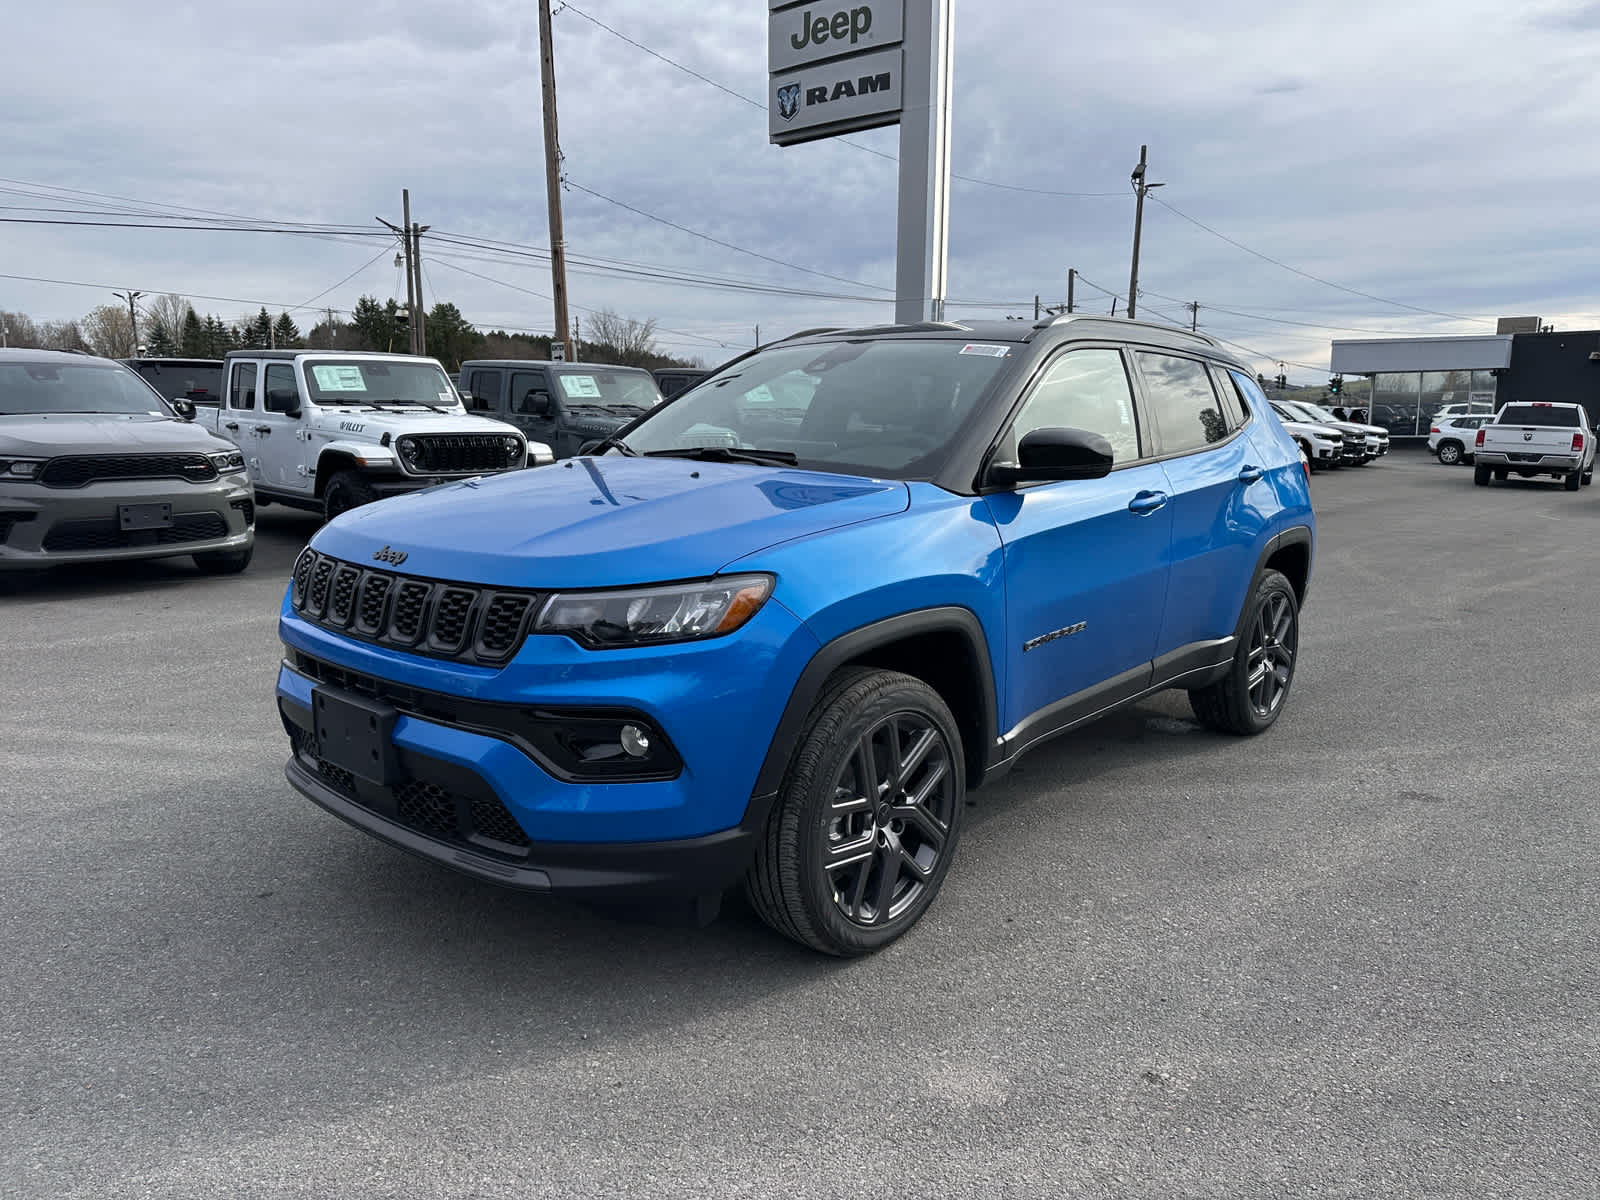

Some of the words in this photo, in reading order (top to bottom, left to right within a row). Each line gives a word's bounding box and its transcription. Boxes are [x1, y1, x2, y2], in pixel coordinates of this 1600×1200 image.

[791, 6, 872, 50] Jeep
[806, 72, 891, 106] RAM
[373, 544, 408, 567] Jeep
